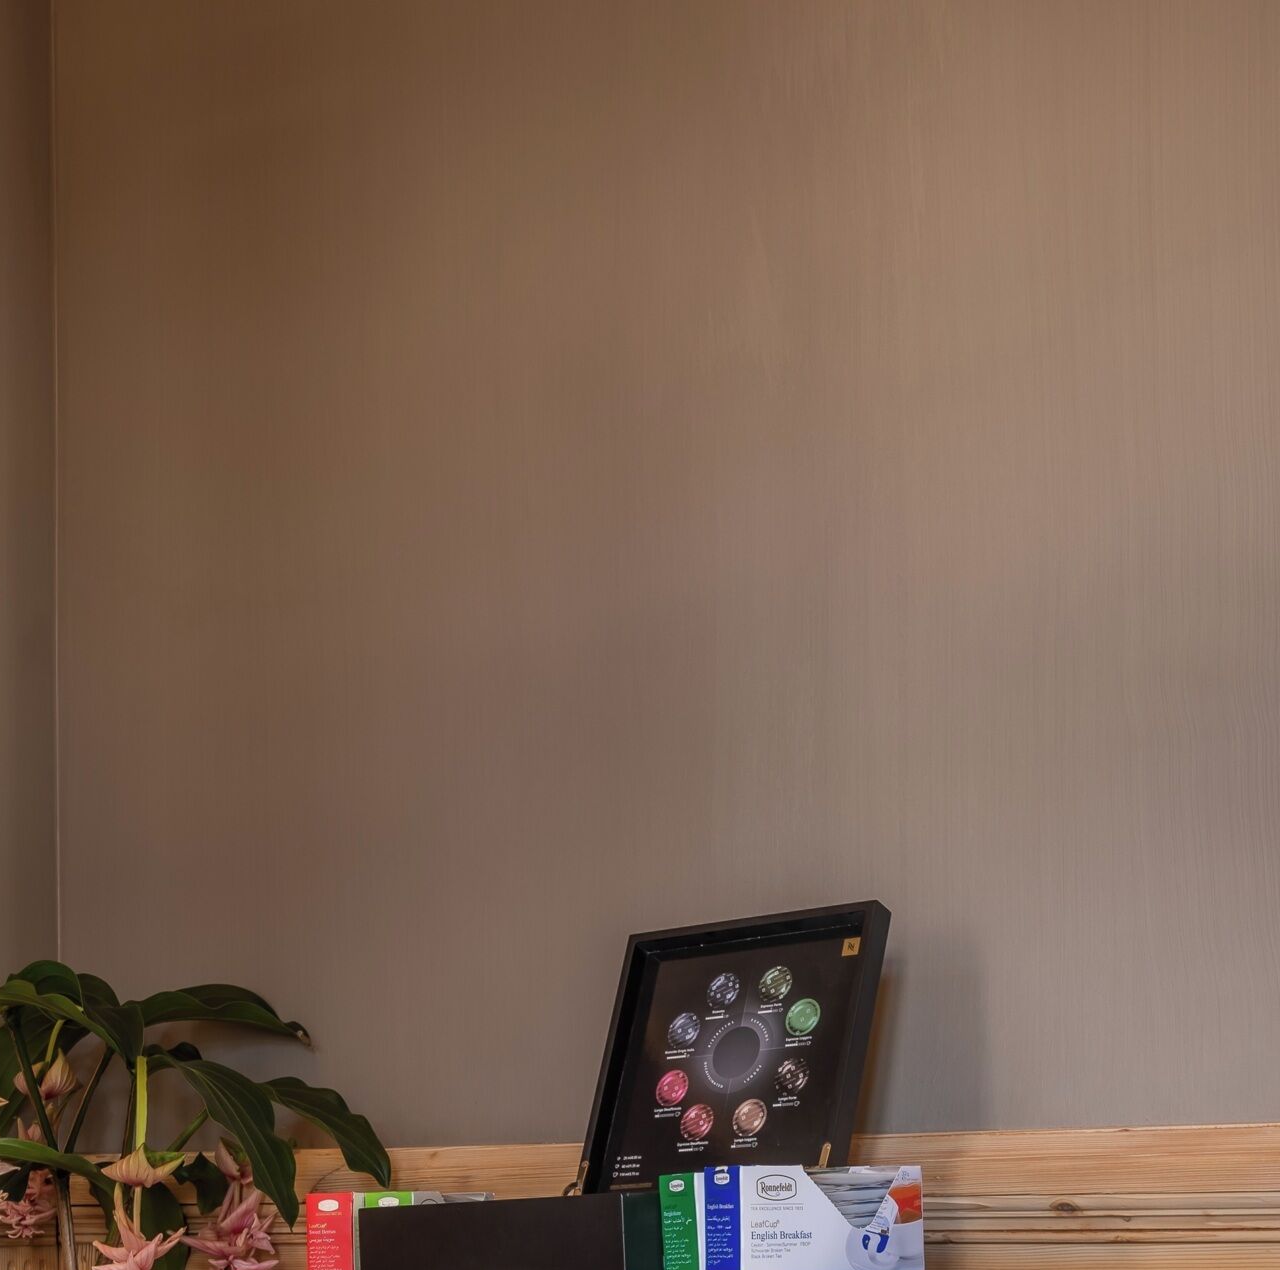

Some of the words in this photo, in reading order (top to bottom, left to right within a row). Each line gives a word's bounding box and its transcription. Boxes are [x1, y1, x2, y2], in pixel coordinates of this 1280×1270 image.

[760, 1181, 793, 1197] Ronnefeldt
[751, 1231, 778, 1242] English
[780, 1230, 813, 1240] Breakfast
